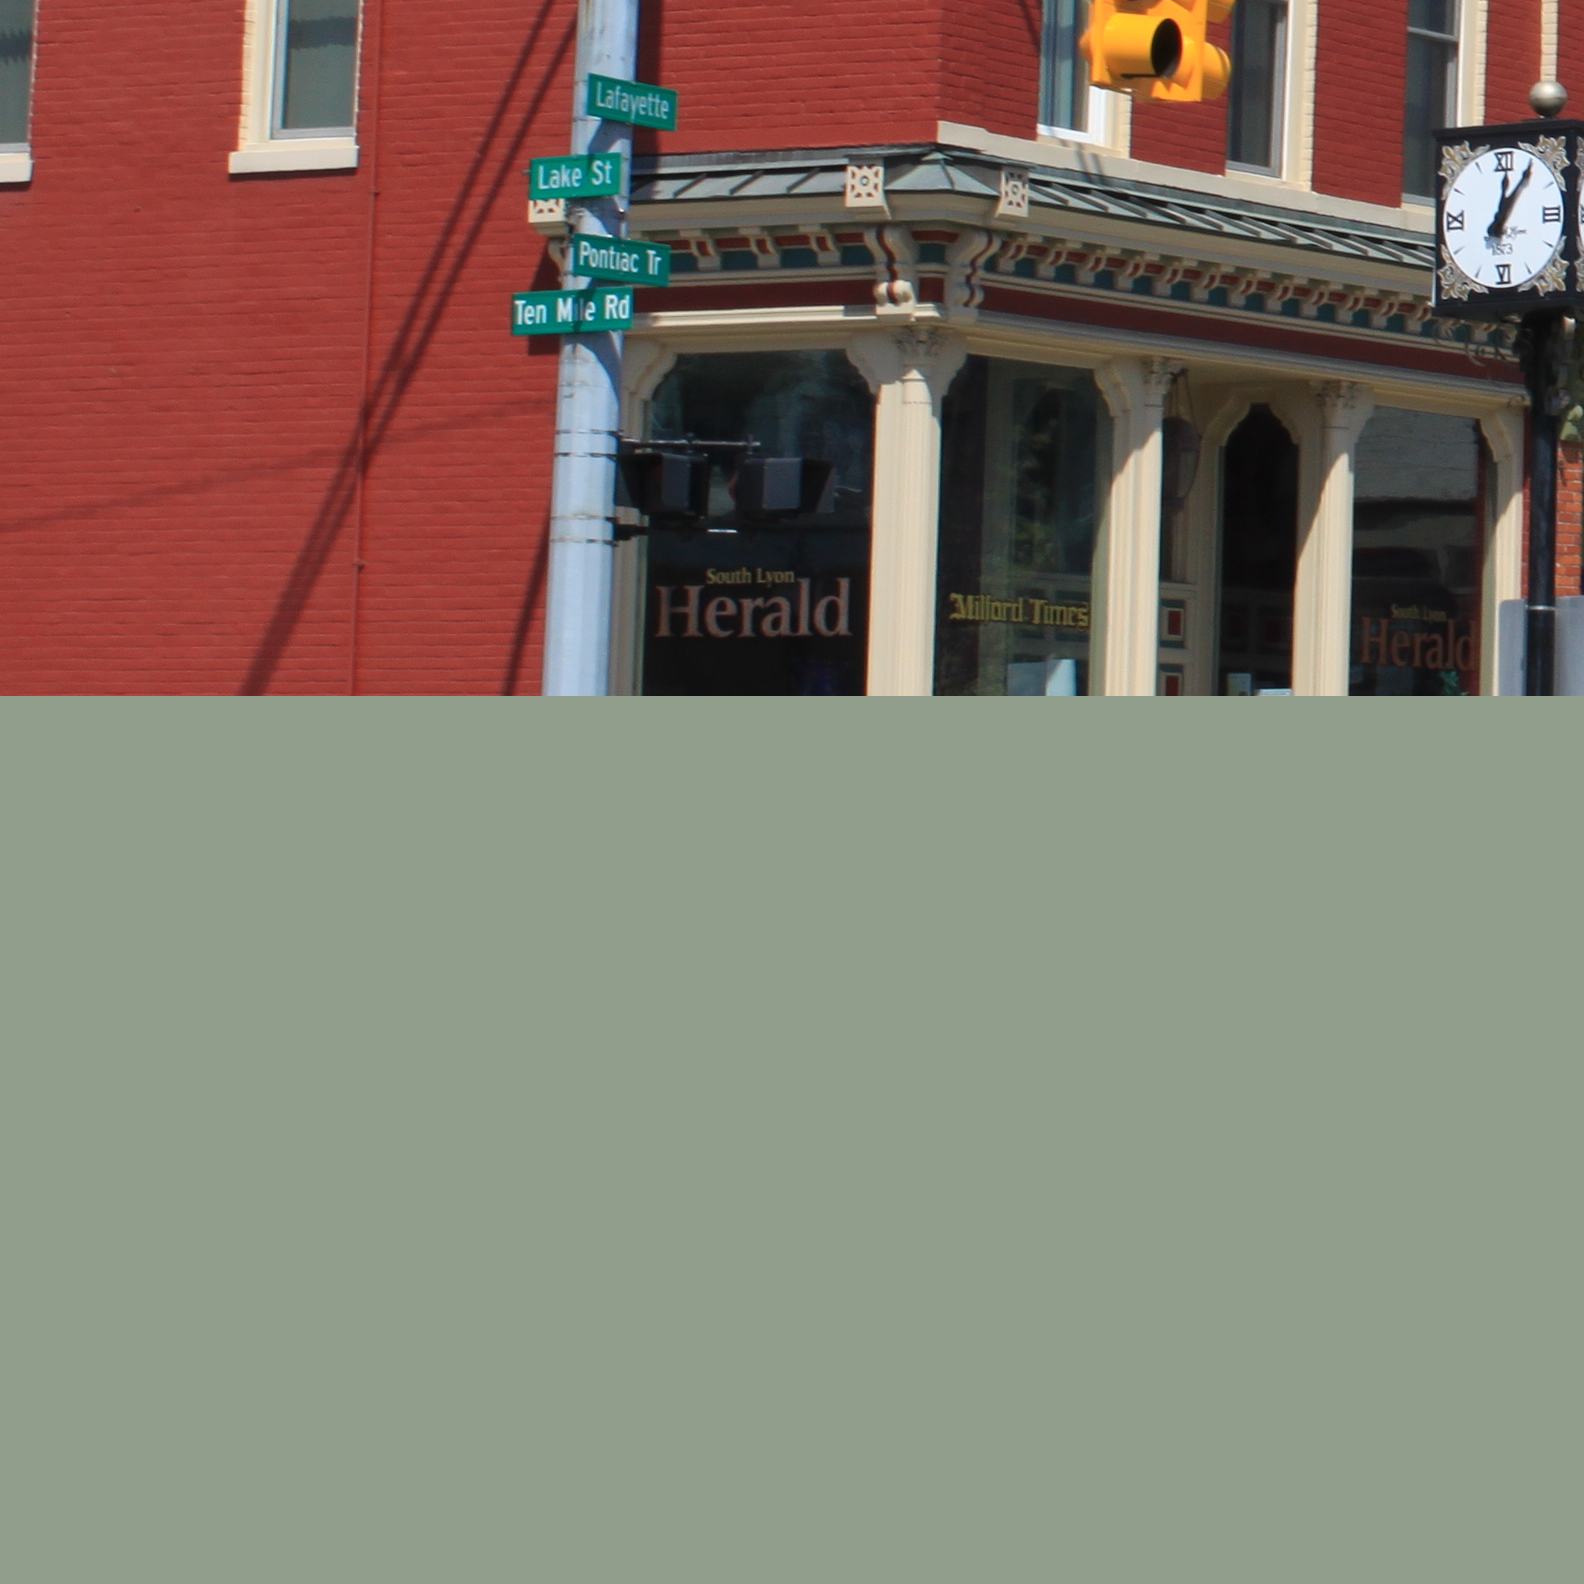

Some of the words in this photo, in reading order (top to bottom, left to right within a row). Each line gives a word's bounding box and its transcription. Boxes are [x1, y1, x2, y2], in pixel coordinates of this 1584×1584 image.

[596, 82, 670, 120] Lafayette
[537, 163, 582, 190] Lake
[591, 160, 613, 185] St
[1494, 151, 1513, 172] XII
[1447, 210, 1464, 232] IX
[1542, 205, 1562, 224] III
[578, 241, 639, 274] Pontiac
[646, 250, 663, 276] Tr
[1495, 264, 1511, 285] VI
[514, 300, 547, 326] Ten
[556, 297, 596, 323] Mile
[604, 294, 631, 320] Rd
[706, 567, 752, 584] South
[756, 568, 796, 588] Lyon
[655, 577, 852, 639] Herald
[948, 592, 1024, 624] Milford
[1028, 598, 1090, 629] Times
[1360, 616, 1480, 671] Herald
